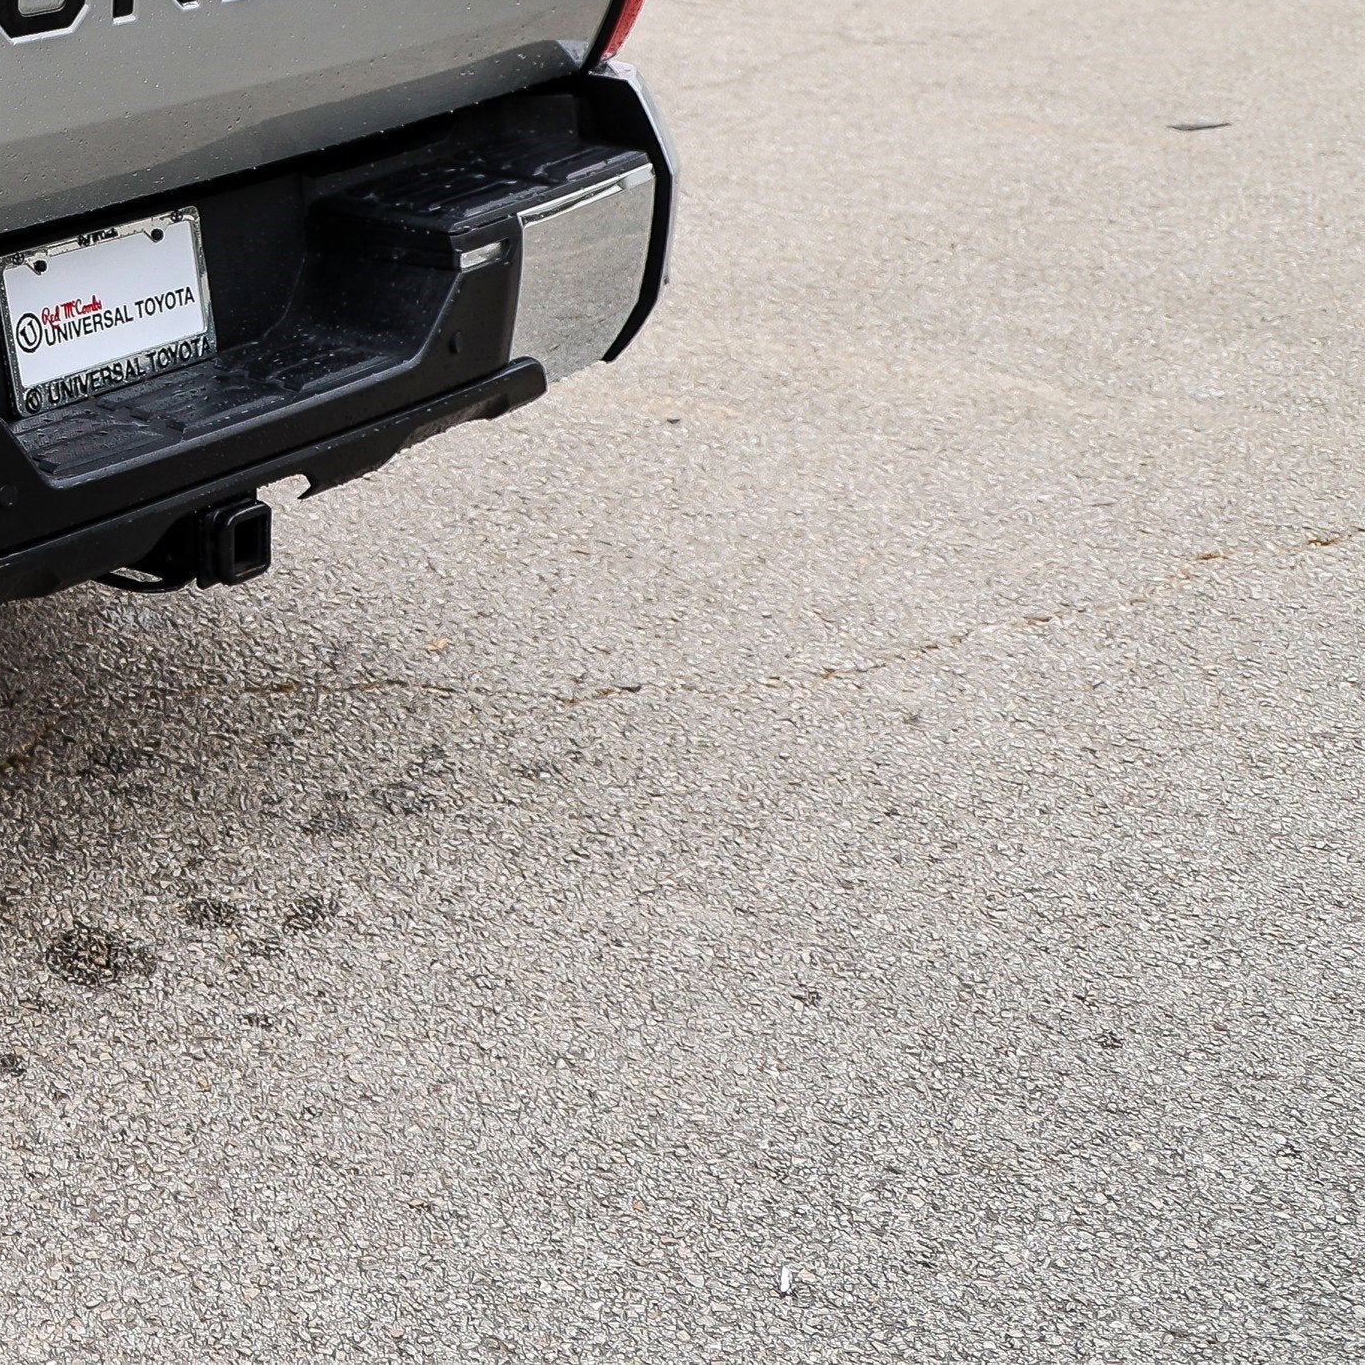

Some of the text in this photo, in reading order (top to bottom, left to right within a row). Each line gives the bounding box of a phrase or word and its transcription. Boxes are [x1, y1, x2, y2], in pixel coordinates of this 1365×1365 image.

[41, 306, 62, 329] Red
[44, 305, 134, 346] UNIVERSAL
[134, 286, 195, 319] TOYOTA
[48, 357, 147, 404] UNIVERSAL
[146, 335, 211, 370] TOYOTA
